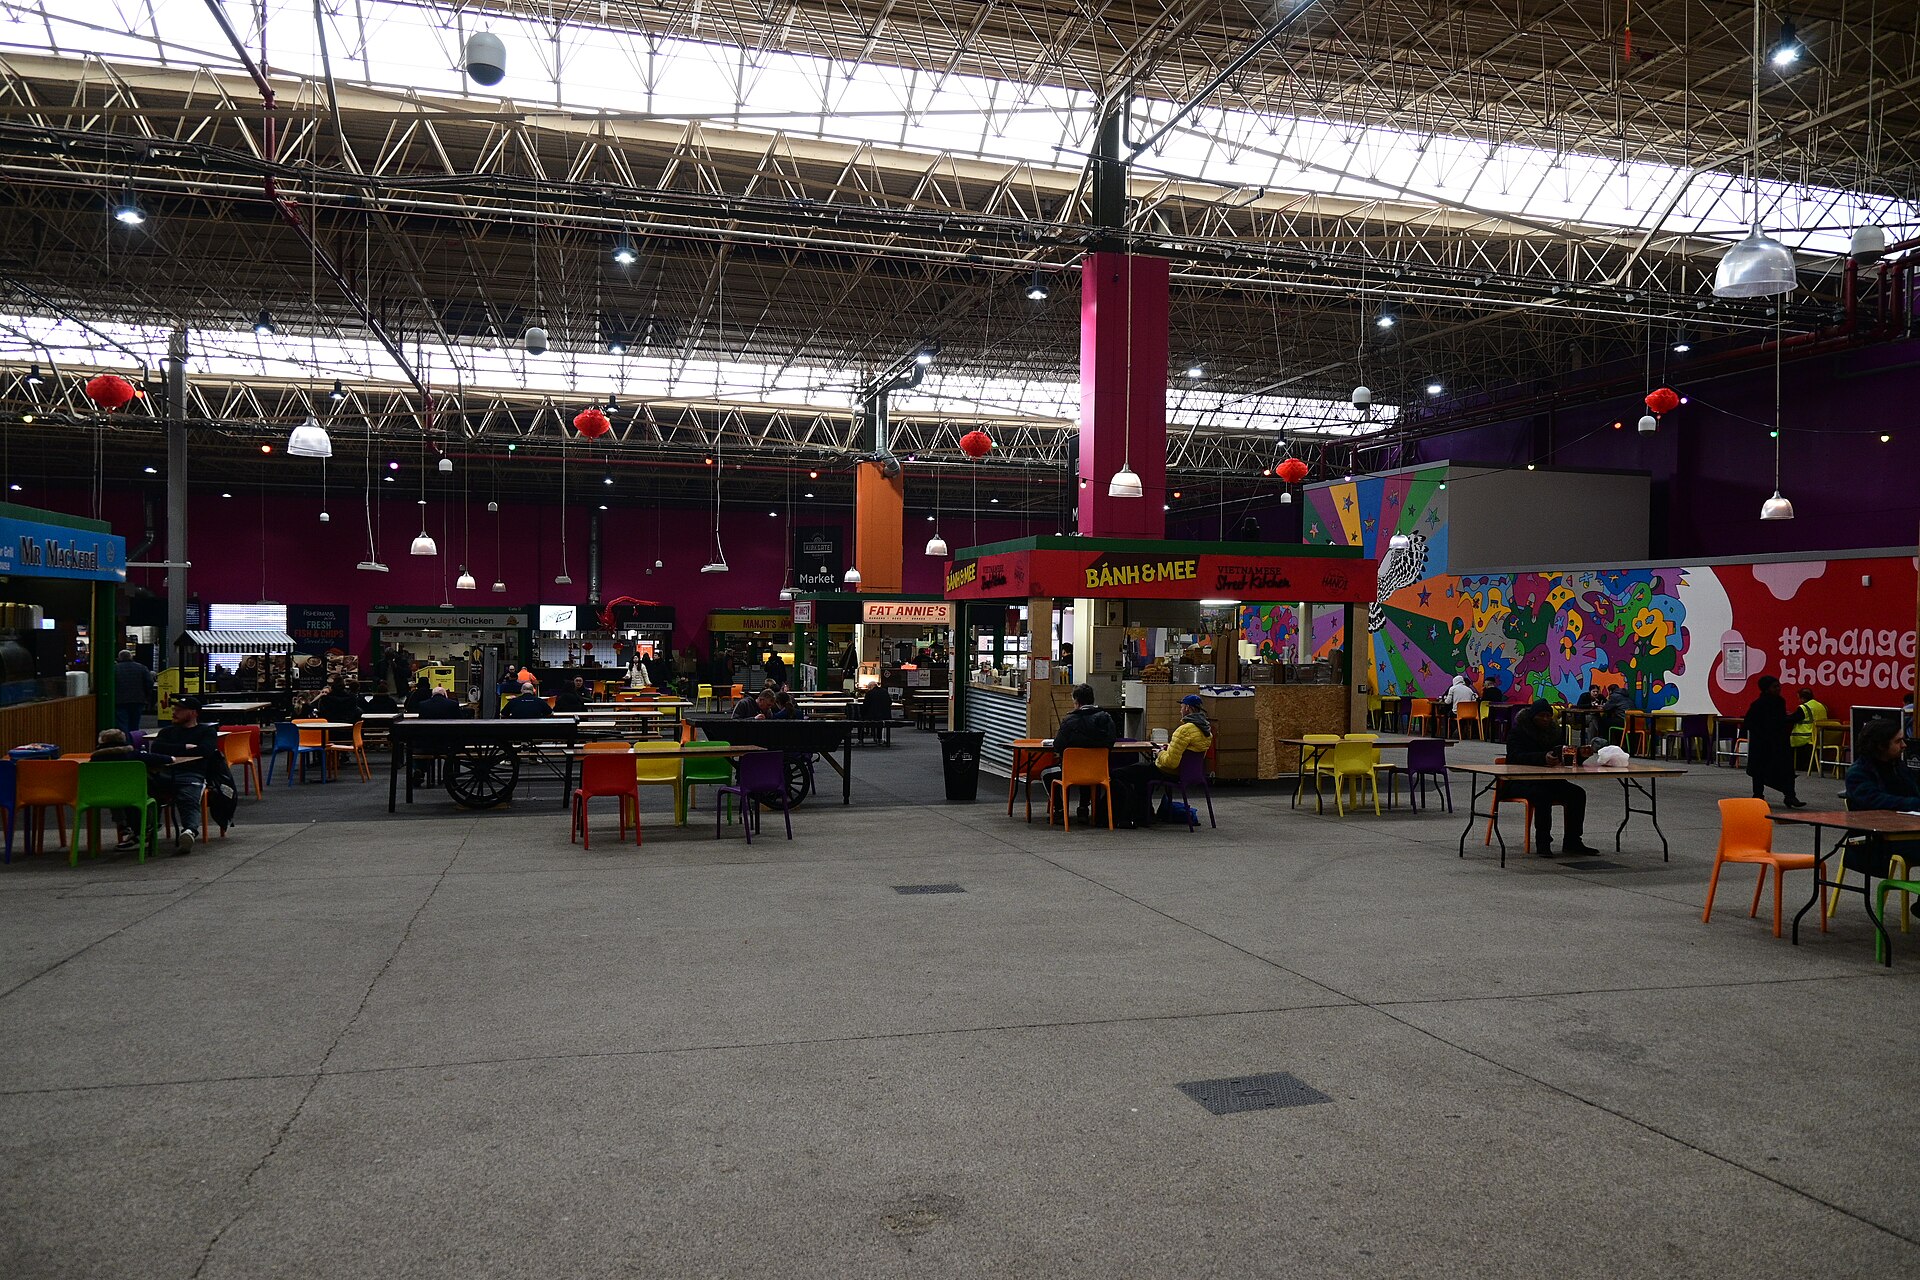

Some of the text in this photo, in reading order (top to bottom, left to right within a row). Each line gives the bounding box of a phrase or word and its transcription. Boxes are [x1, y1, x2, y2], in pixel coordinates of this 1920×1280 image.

[1217, 565, 1283, 576] VIETNAMESE
[799, 573, 835, 584] Market
[869, 605, 947, 617] FAT ANNIE'S
[306, 620, 332, 629] FRESH
[403, 616, 494, 626] Jenny's Jerk Chicken
[743, 619, 777, 629] MANJIT'S
[1778, 625, 1916, 659] #change
